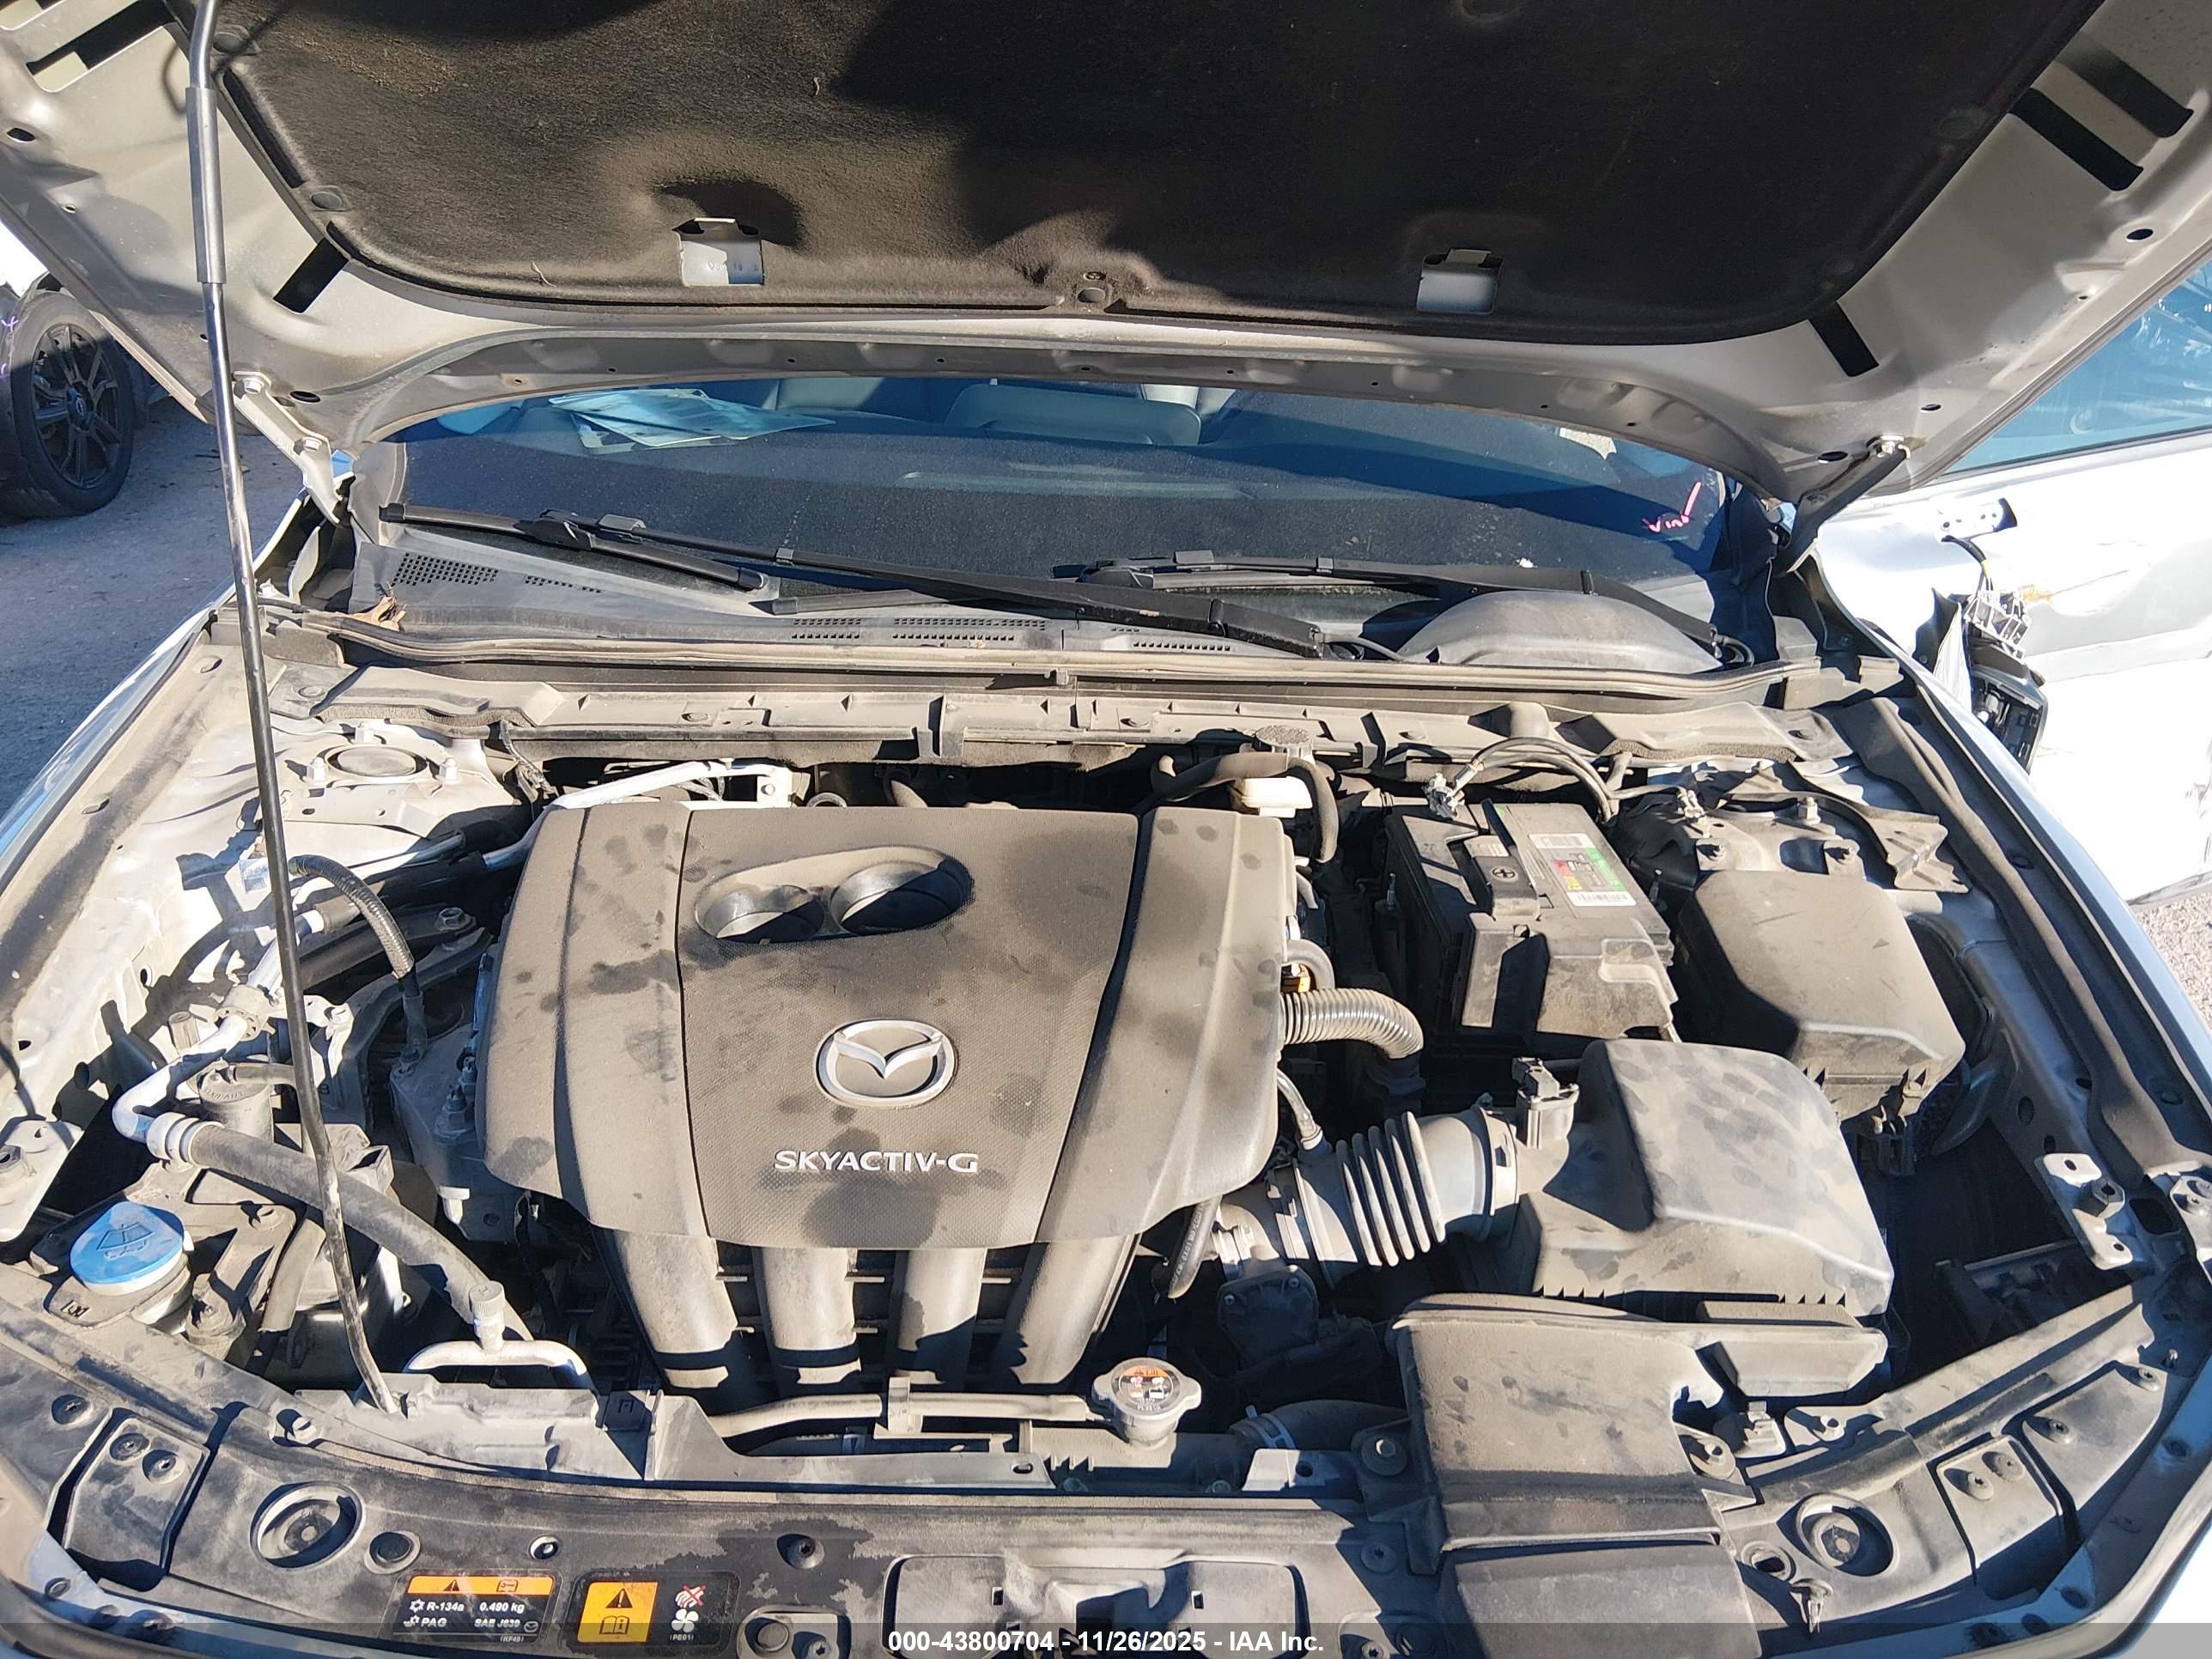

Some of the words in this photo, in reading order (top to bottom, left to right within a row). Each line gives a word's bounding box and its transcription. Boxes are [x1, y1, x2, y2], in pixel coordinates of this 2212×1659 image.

[774, 1149, 980, 1174] SKYACTIV-G
[426, 1601, 465, 1612] R-134a
[479, 1601, 508, 1612] 0.490
[511, 1602, 525, 1614] kg
[420, 1618, 447, 1628] PAG
[474, 1619, 495, 1628] SAE
[497, 1619, 520, 1628] J639
